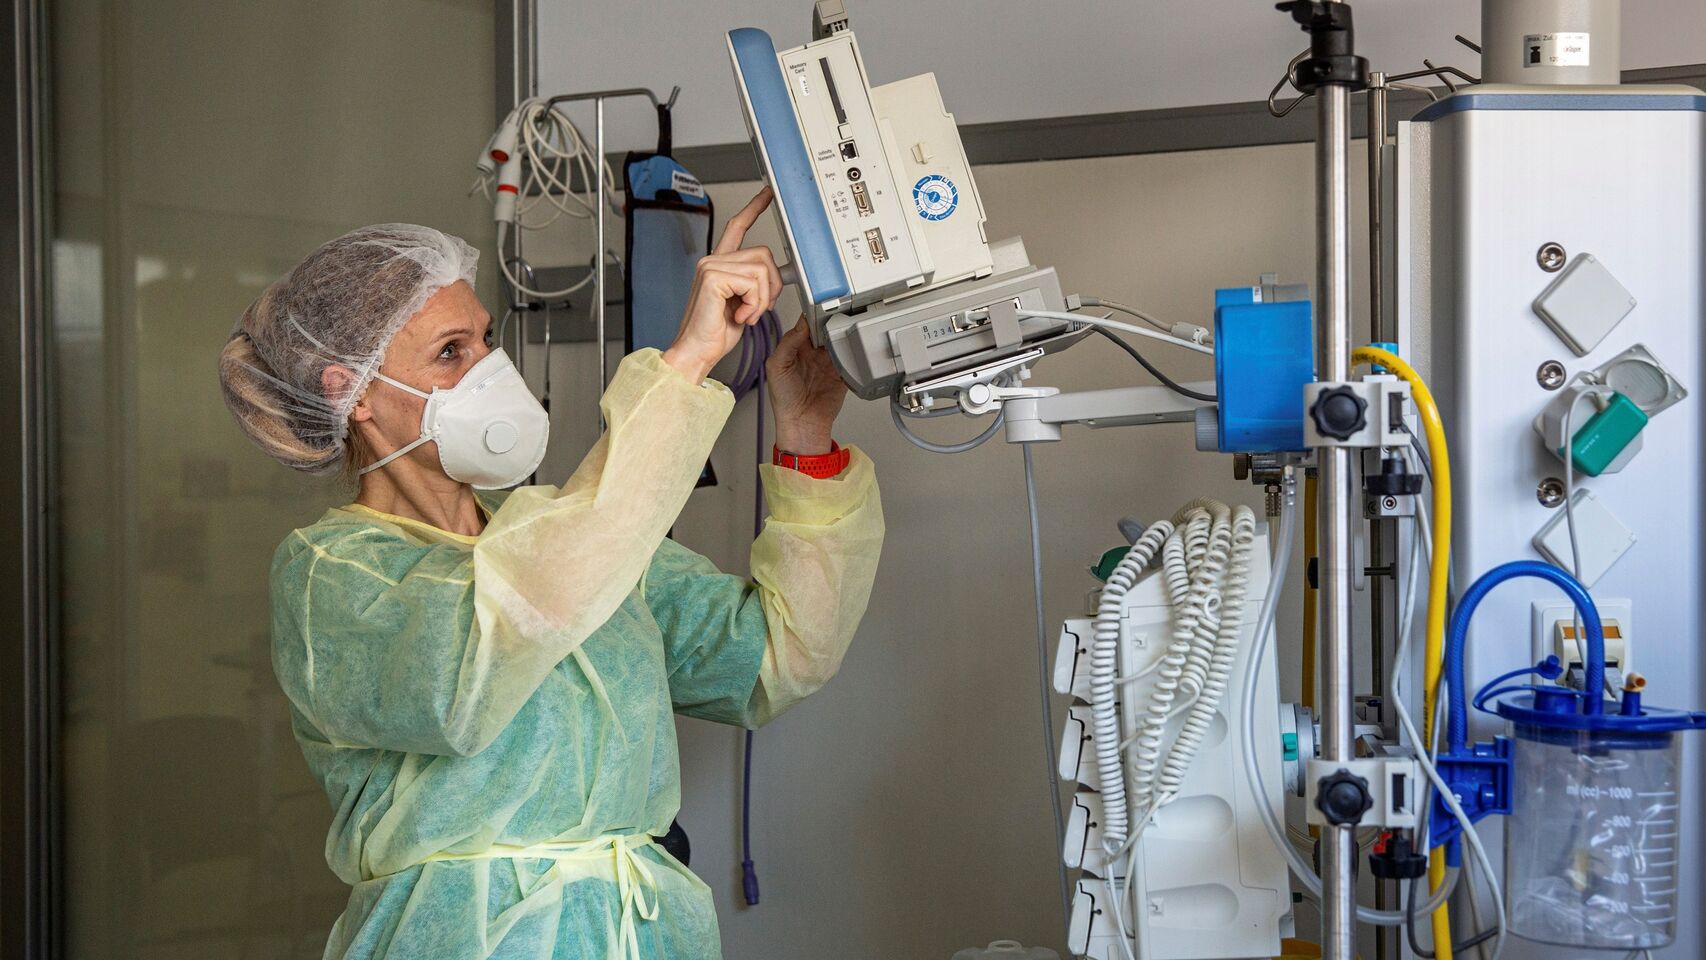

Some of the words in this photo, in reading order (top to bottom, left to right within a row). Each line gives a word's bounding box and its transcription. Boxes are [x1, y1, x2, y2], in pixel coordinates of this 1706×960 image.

[789, 62, 807, 70] Memory
[818, 153, 835, 161] Network
[1566, 784, 1579, 795] ml
[1580, 785, 1599, 799] (cc)
